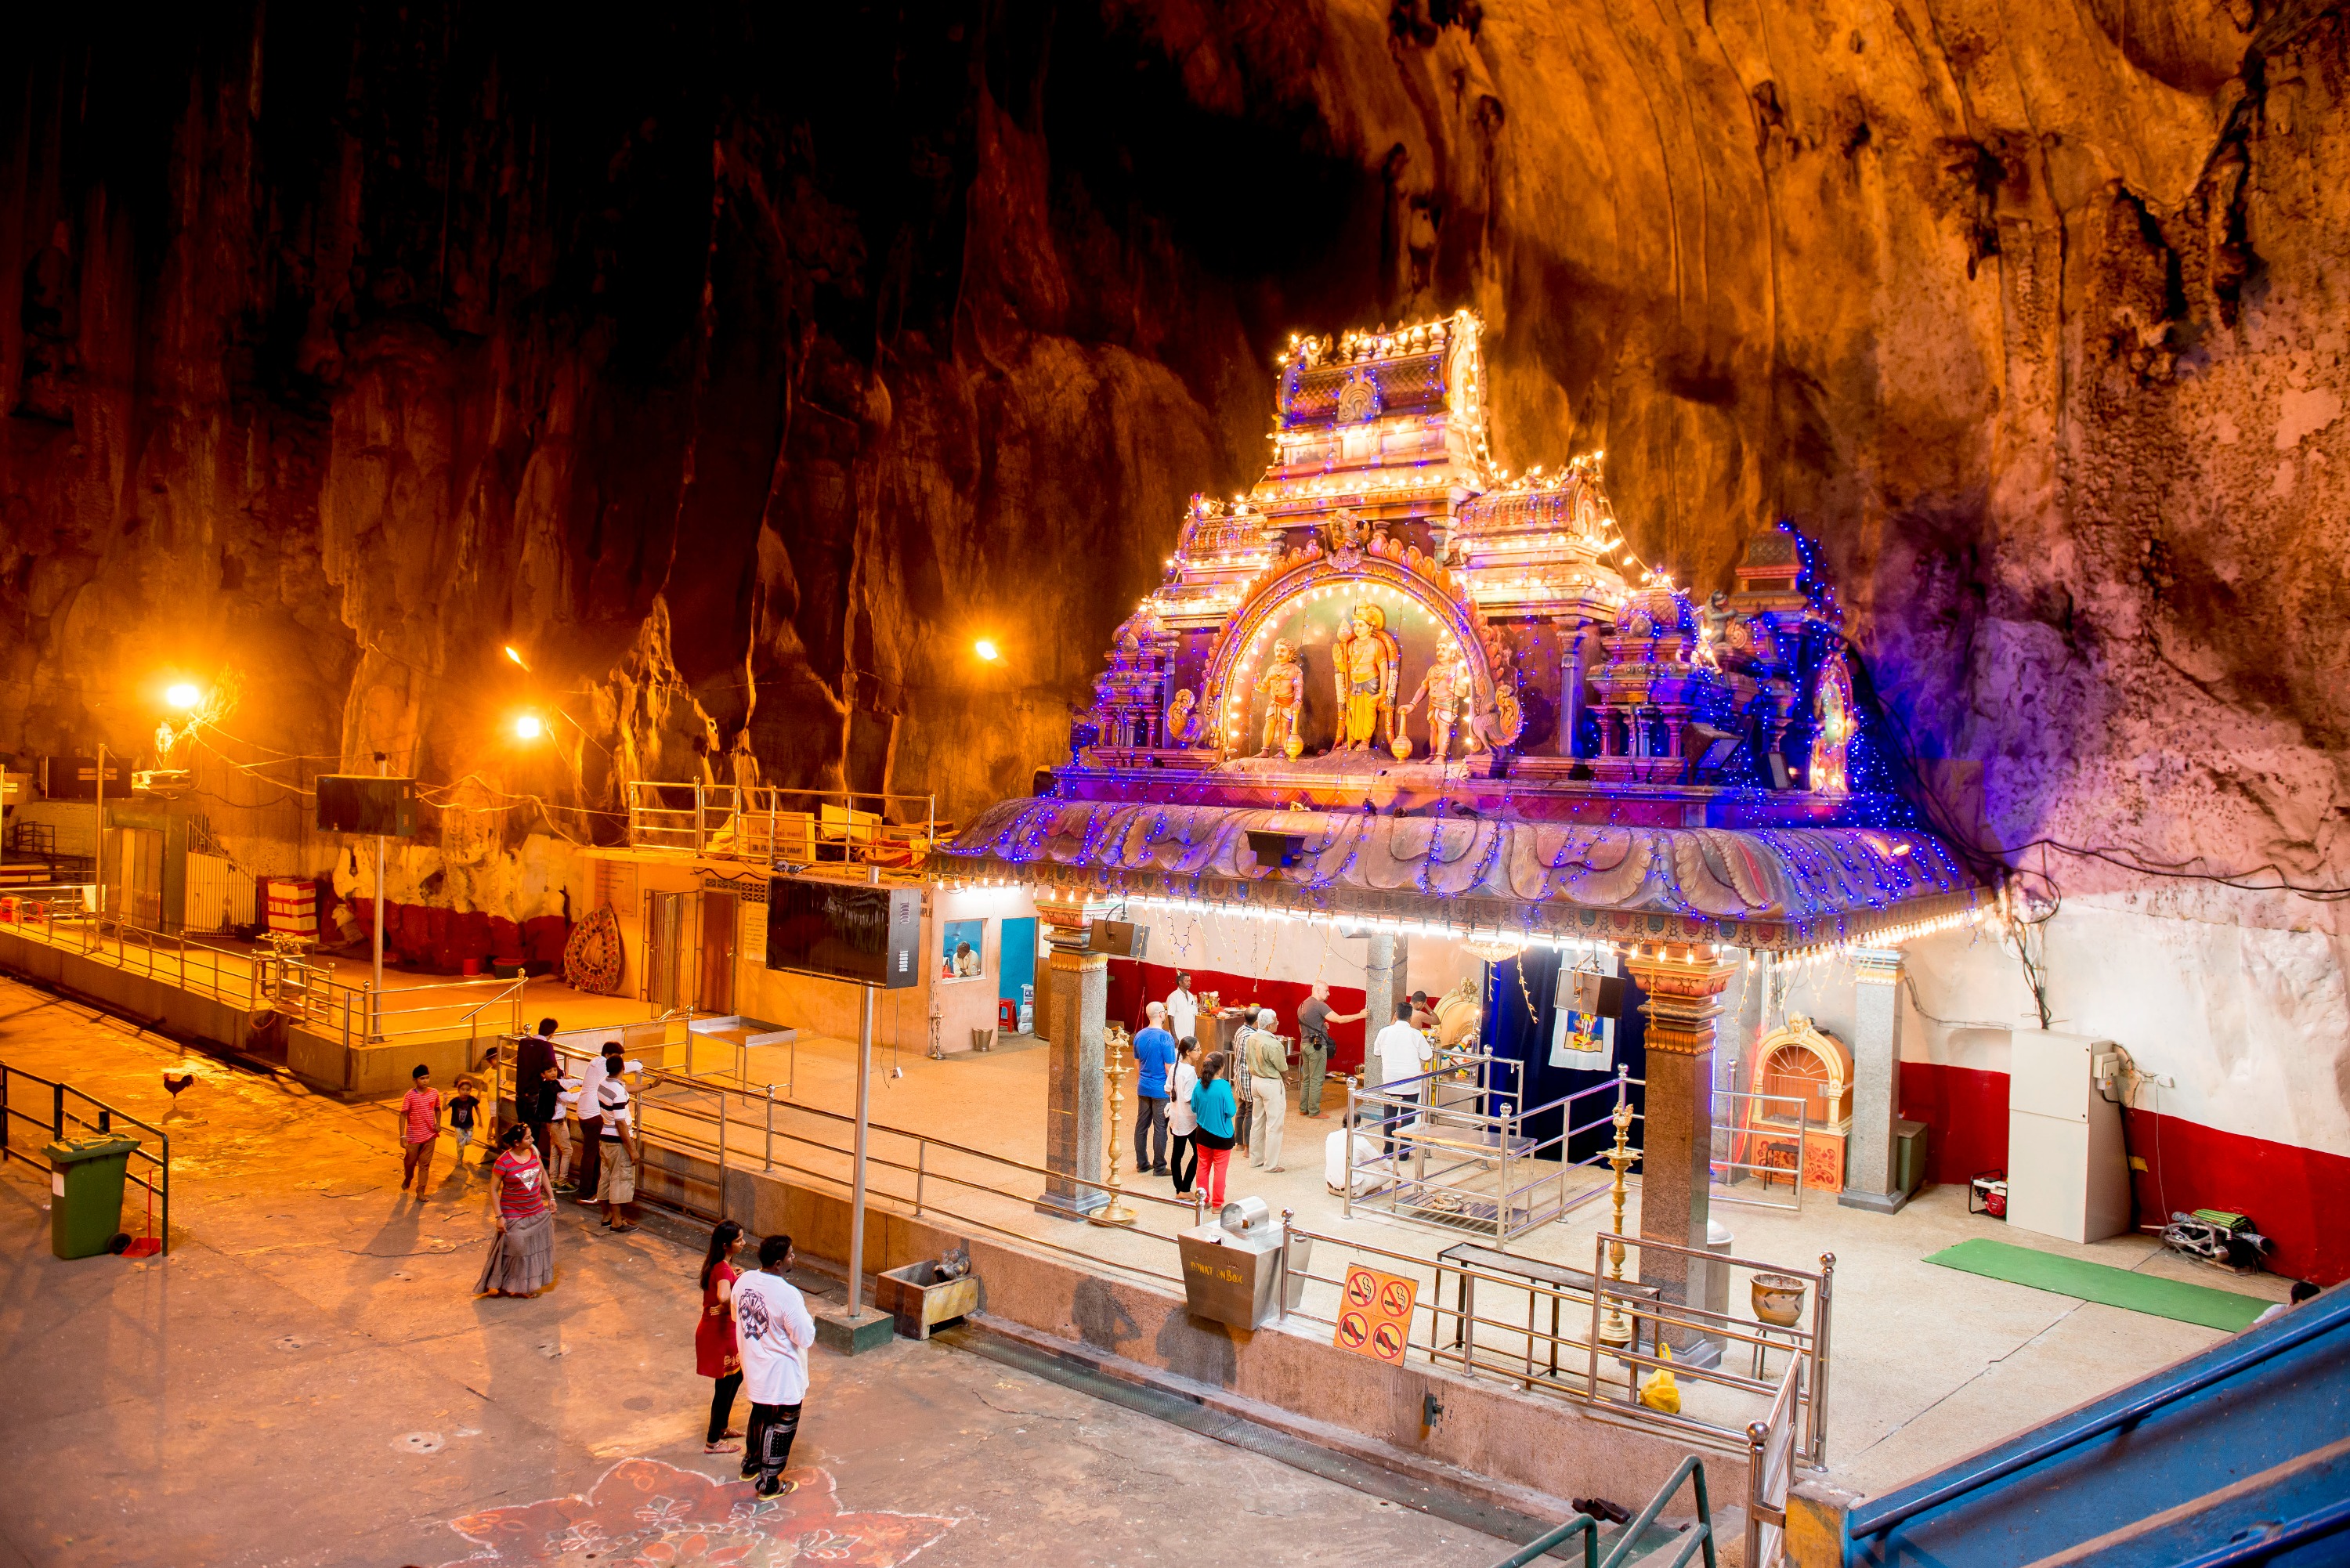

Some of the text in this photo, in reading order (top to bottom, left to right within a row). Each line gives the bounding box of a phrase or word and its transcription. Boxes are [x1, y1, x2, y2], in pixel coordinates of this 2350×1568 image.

[786, 847, 803, 855] SWAMY
[920, 907, 932, 919] MPLE
[1191, 1261, 1226, 1280] DNATON
